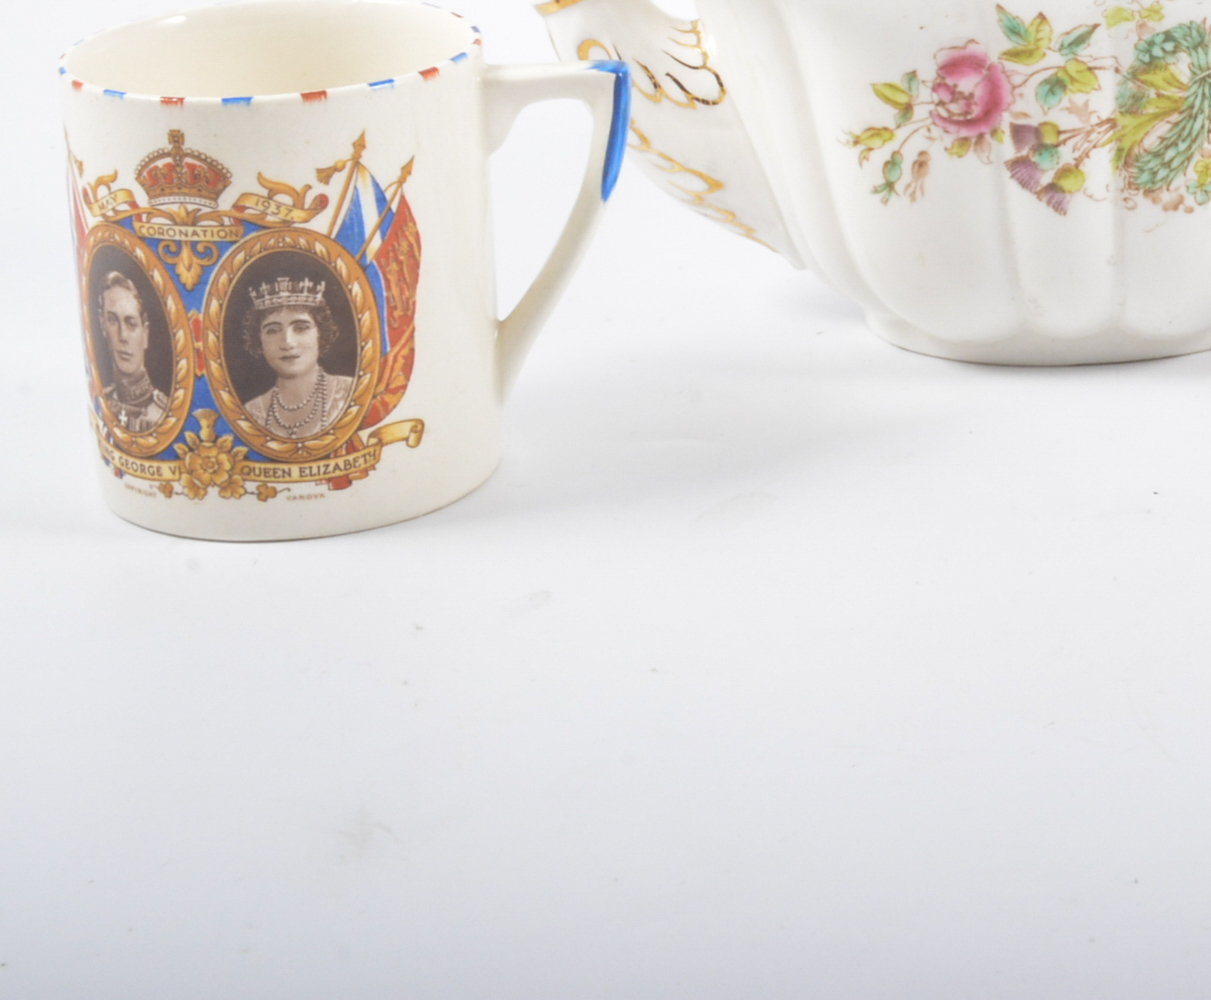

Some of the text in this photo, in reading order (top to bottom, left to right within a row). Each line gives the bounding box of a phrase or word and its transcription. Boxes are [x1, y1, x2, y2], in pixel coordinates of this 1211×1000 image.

[138, 224, 240, 240] CORONATION
[118, 456, 163, 477] GEORGE
[240, 449, 378, 479] QUEEN ELIZABETH
